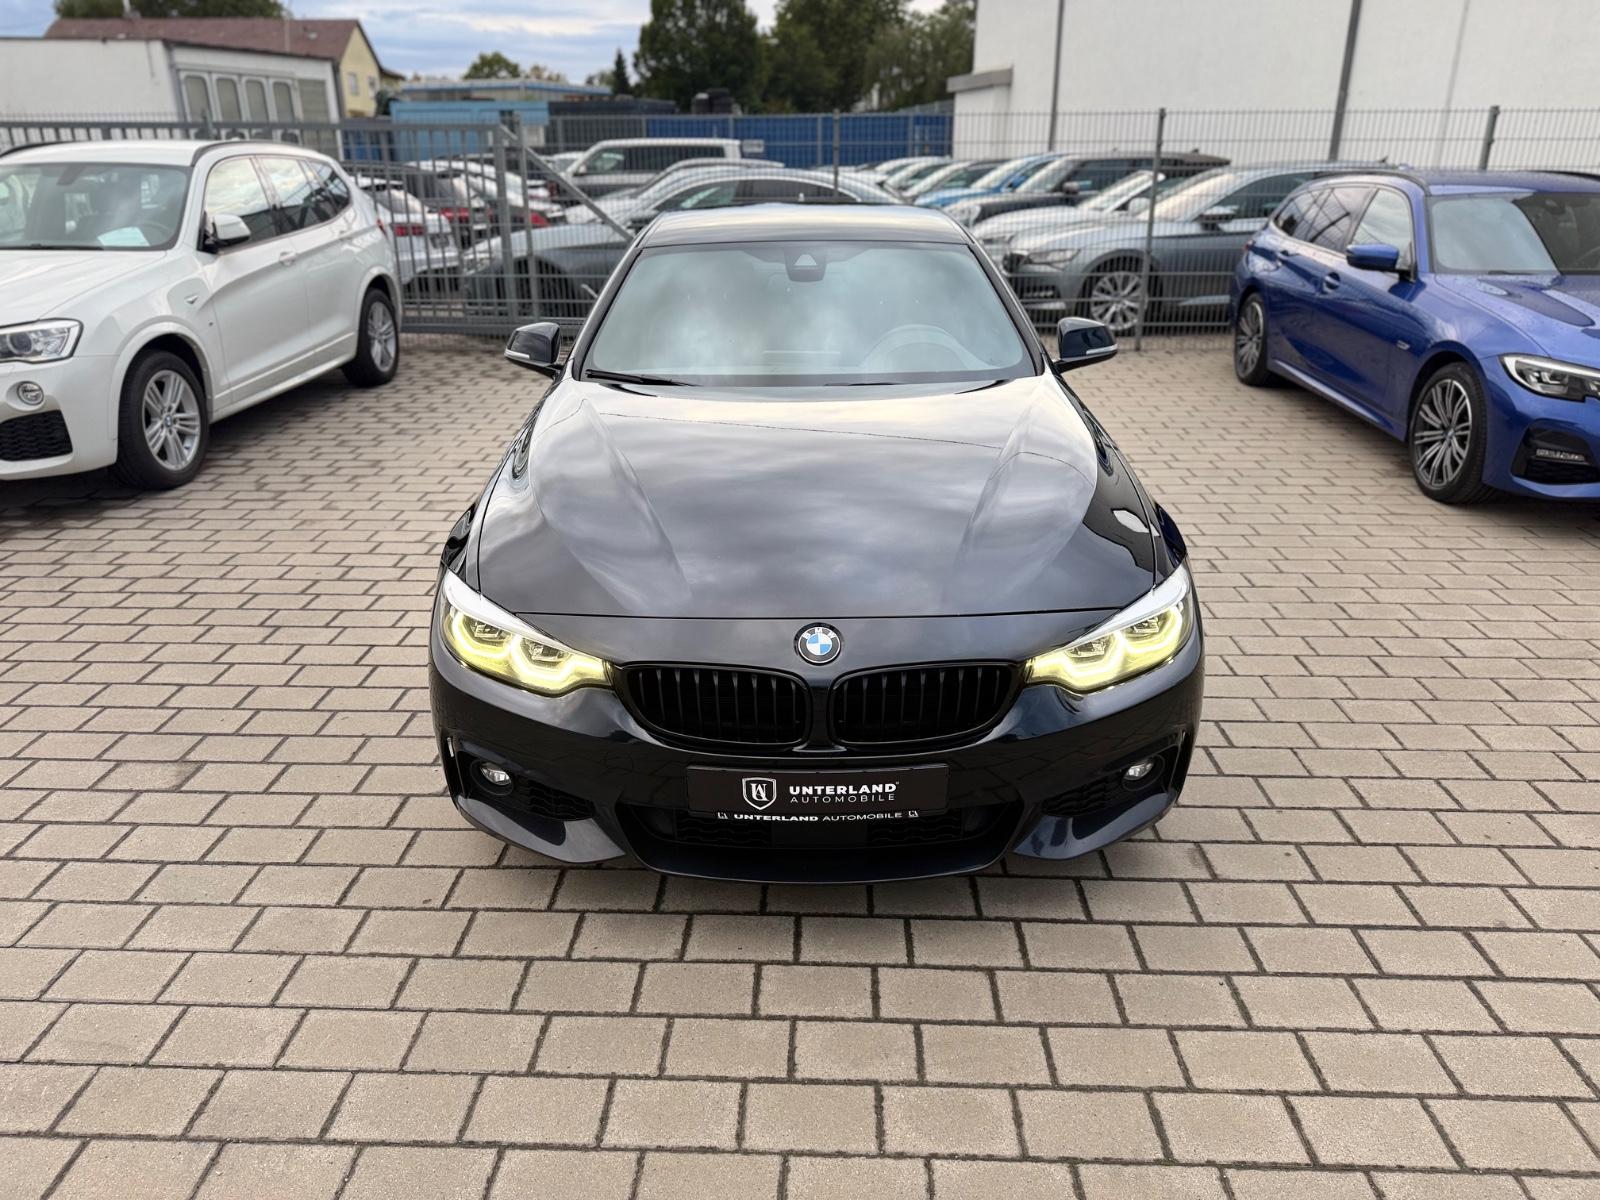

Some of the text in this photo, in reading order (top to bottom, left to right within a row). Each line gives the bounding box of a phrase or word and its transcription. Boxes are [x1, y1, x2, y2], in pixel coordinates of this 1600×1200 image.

[789, 783, 897, 795] UNTERLAND
[790, 794, 895, 804] AUTOMOBILE
[822, 812, 902, 821] AUTOMOBILE
